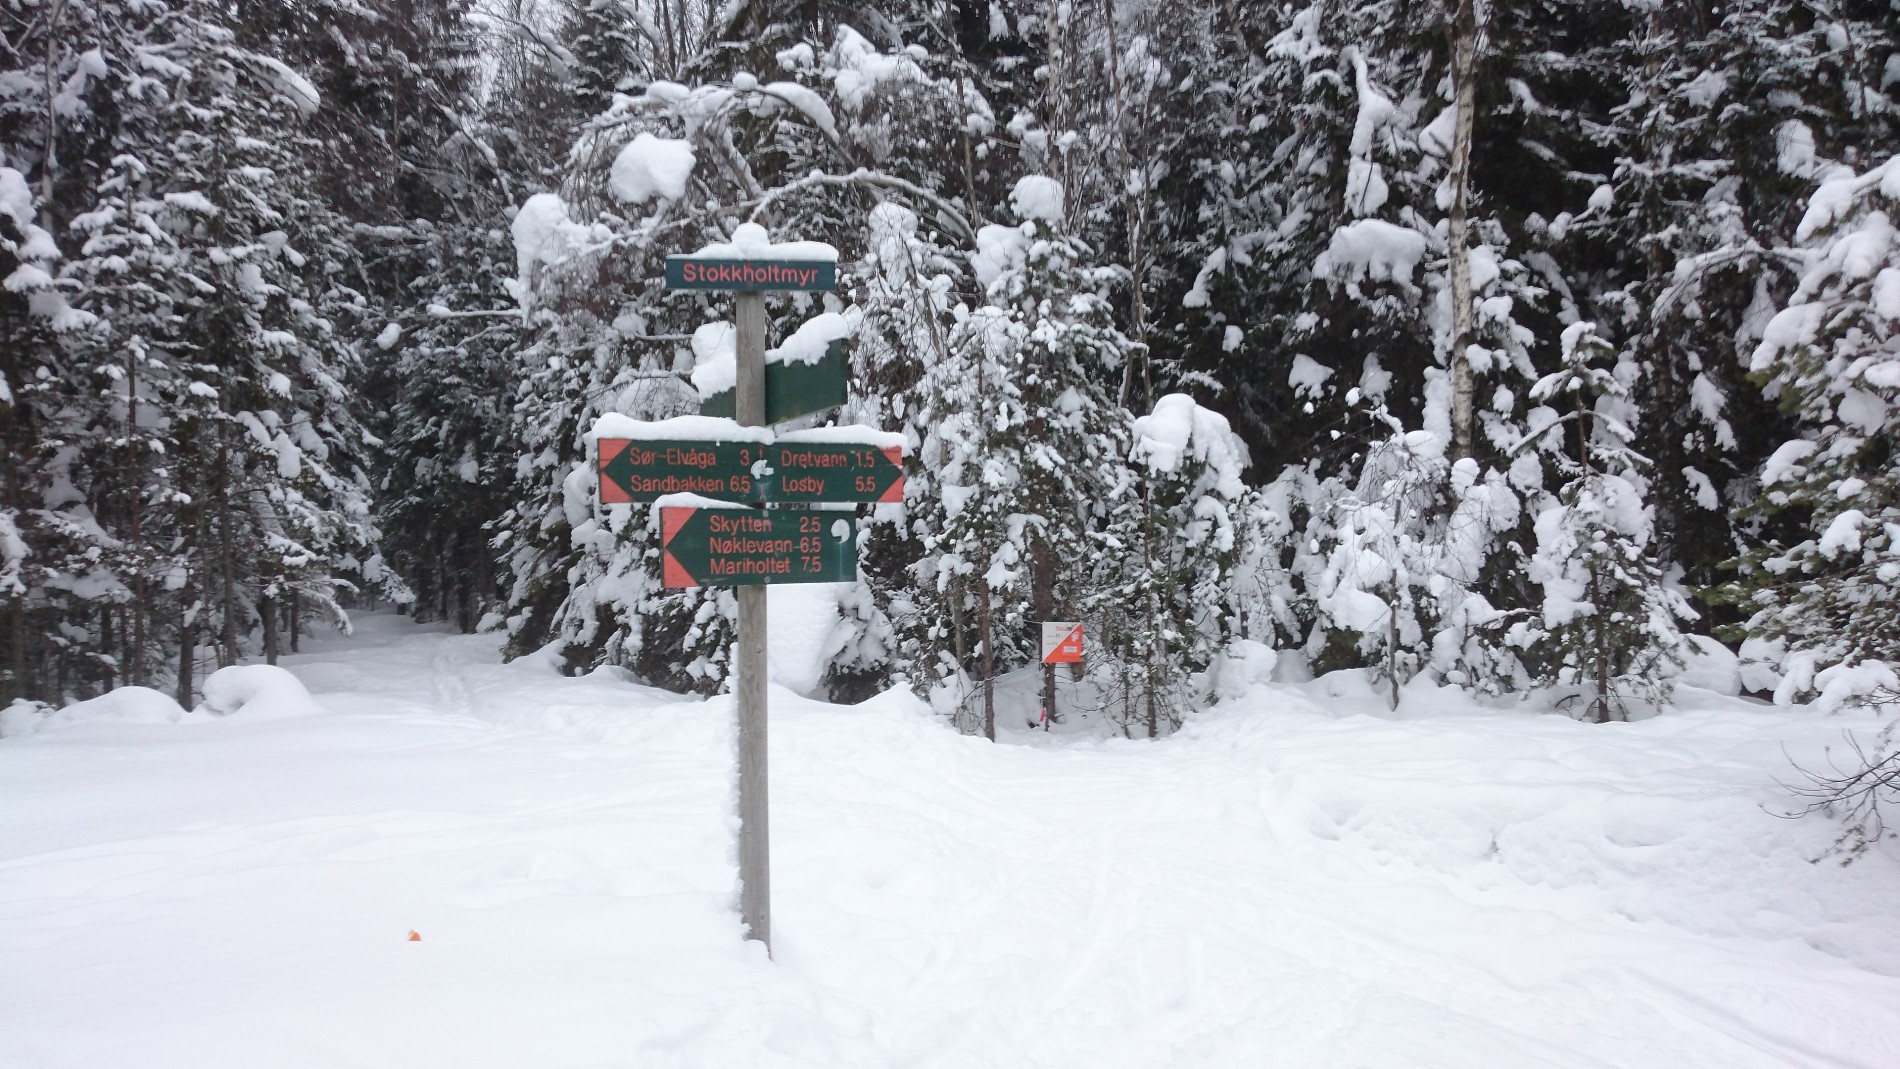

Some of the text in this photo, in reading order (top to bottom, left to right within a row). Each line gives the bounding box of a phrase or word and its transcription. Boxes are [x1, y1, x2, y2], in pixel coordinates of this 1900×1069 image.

[683, 263, 818, 286] Stokkholtmyr
[630, 447, 750, 467] Sør-Elvåga 3
[781, 449, 875, 468] Dretvann 1.5
[630, 474, 724, 493] Sandbakken
[782, 475, 876, 495] Losby 5.5
[710, 515, 821, 534] Skytten 2.5
[709, 536, 821, 554] Nøklevann 6.5
[710, 557, 791, 575] Mariholtet
